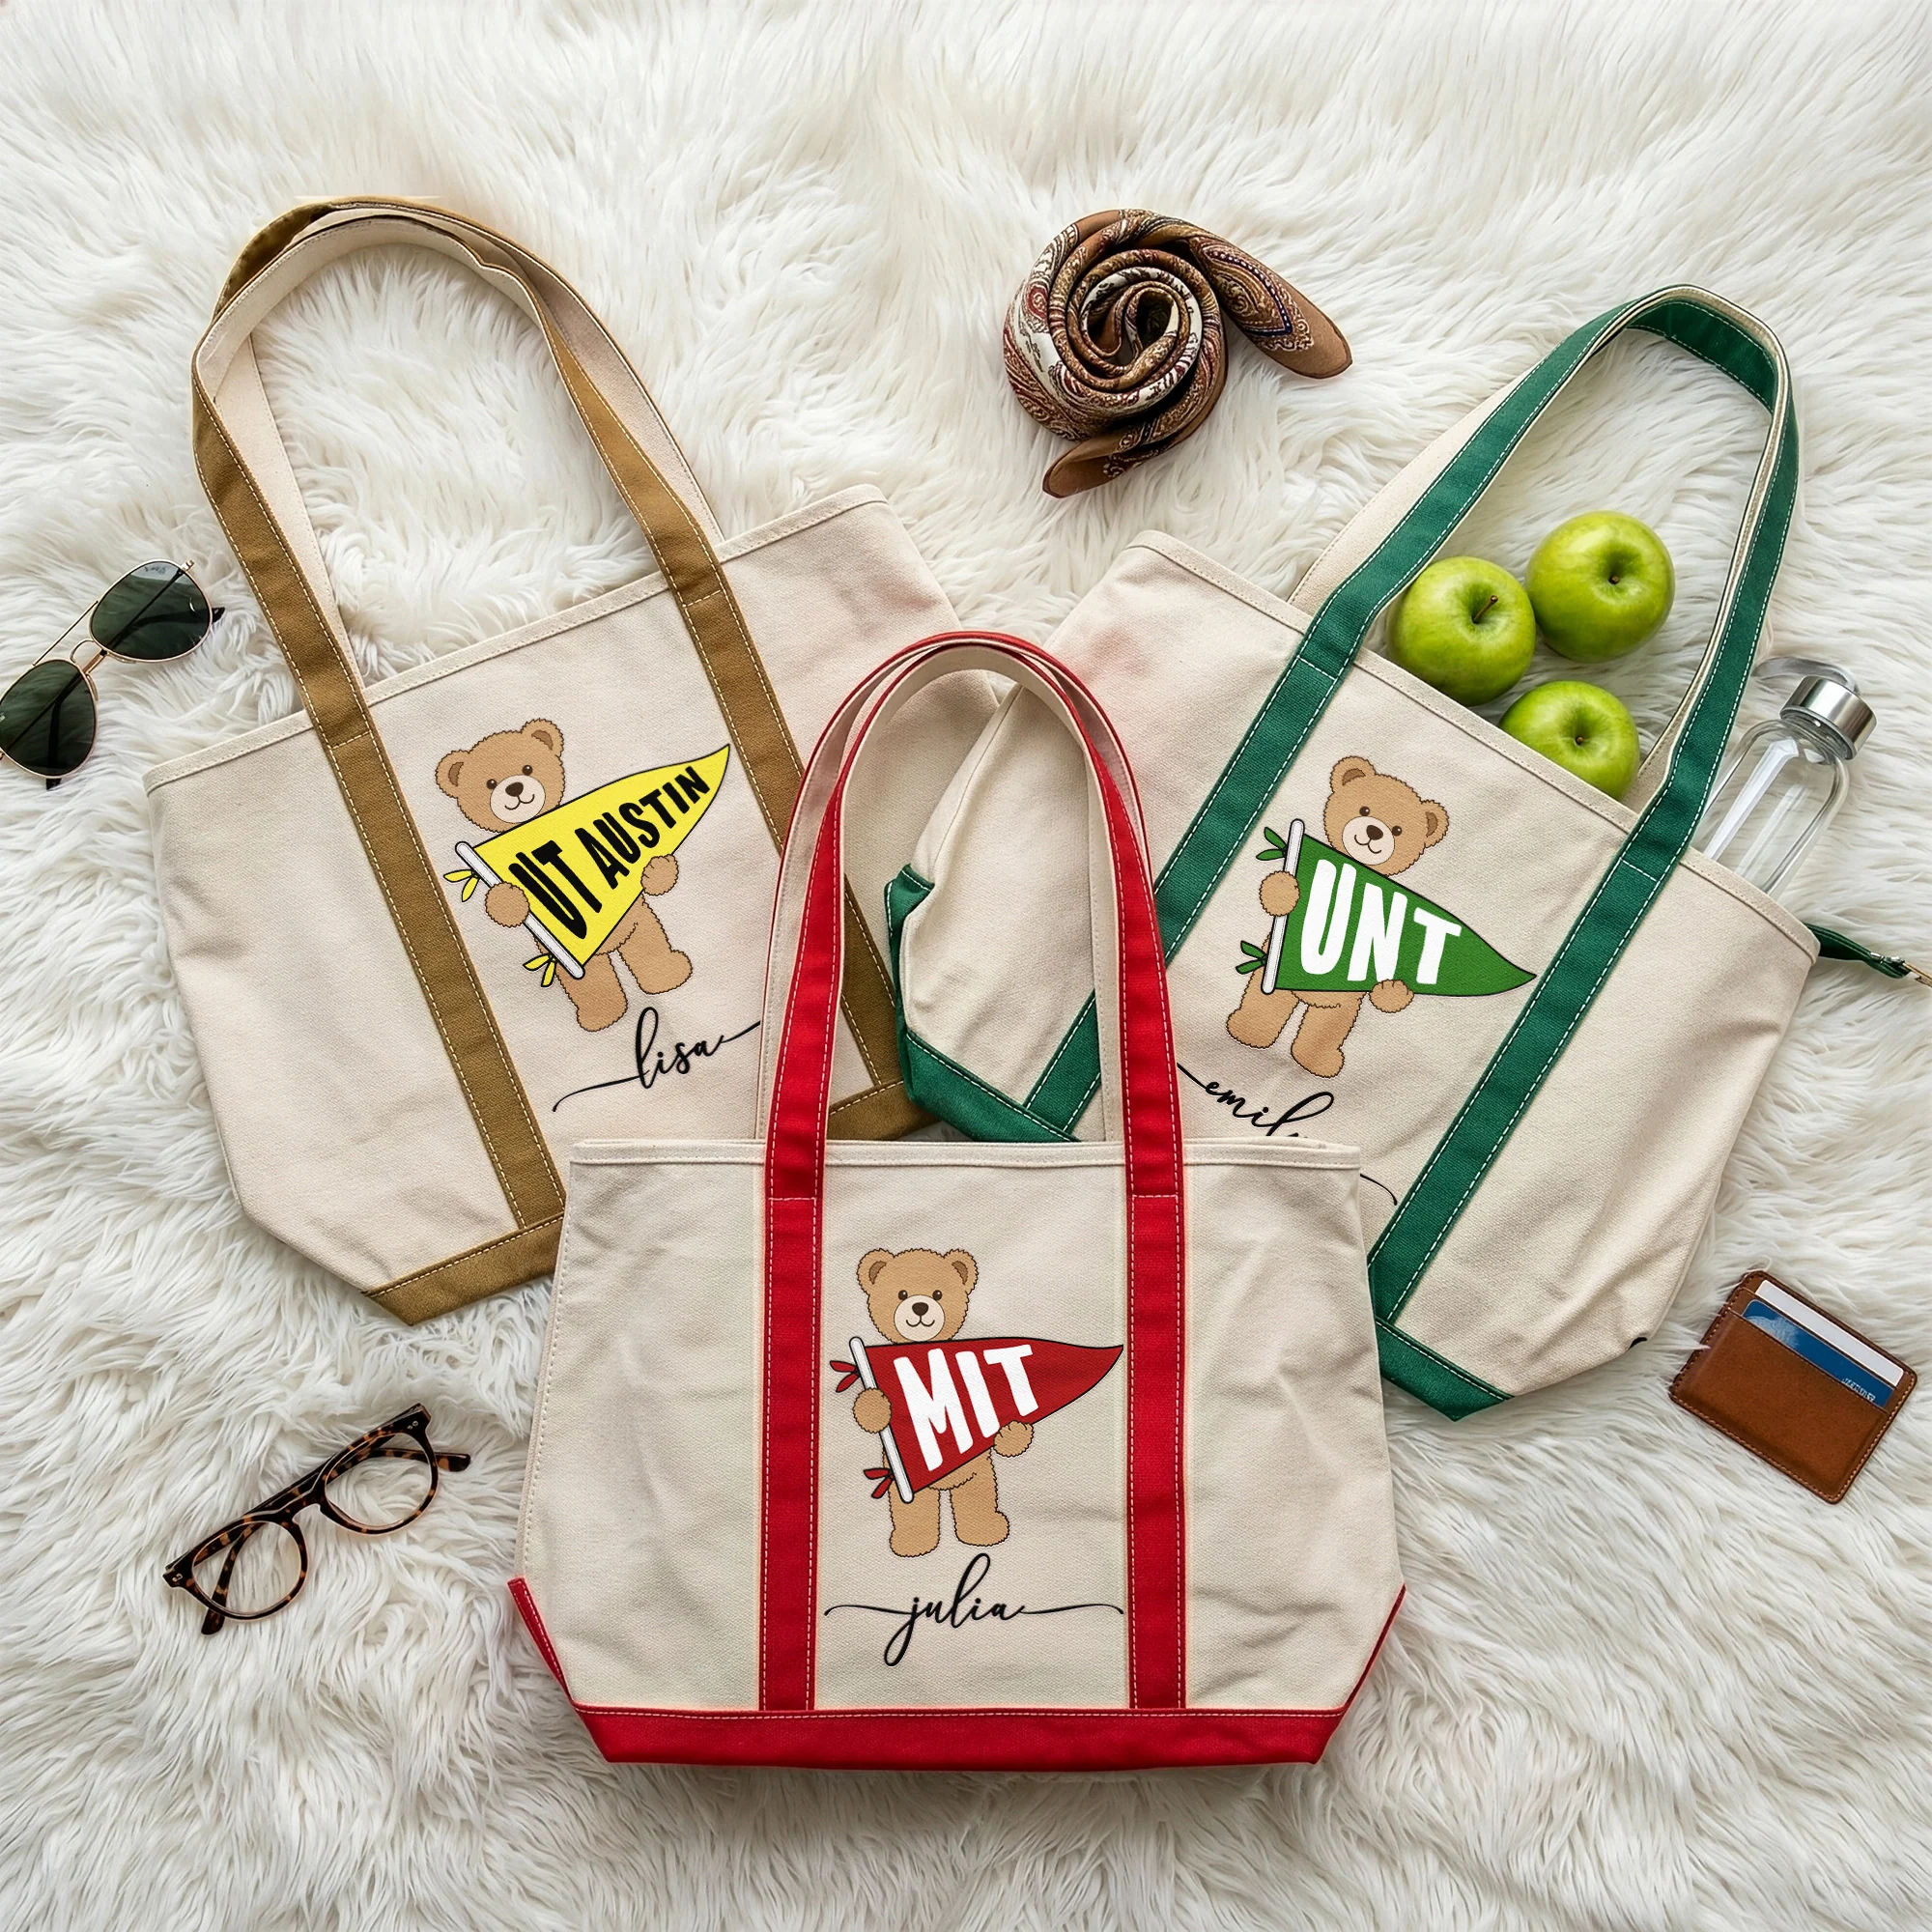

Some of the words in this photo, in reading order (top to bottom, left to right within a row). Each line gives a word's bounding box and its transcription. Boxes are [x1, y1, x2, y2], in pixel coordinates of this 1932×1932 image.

[508, 839, 603, 940] UT
[574, 765, 711, 890] AUSTIN
[1300, 859, 1463, 984] UNT
[1176, 1063, 1335, 1139] emil
[893, 1344, 1039, 1472] MIT
